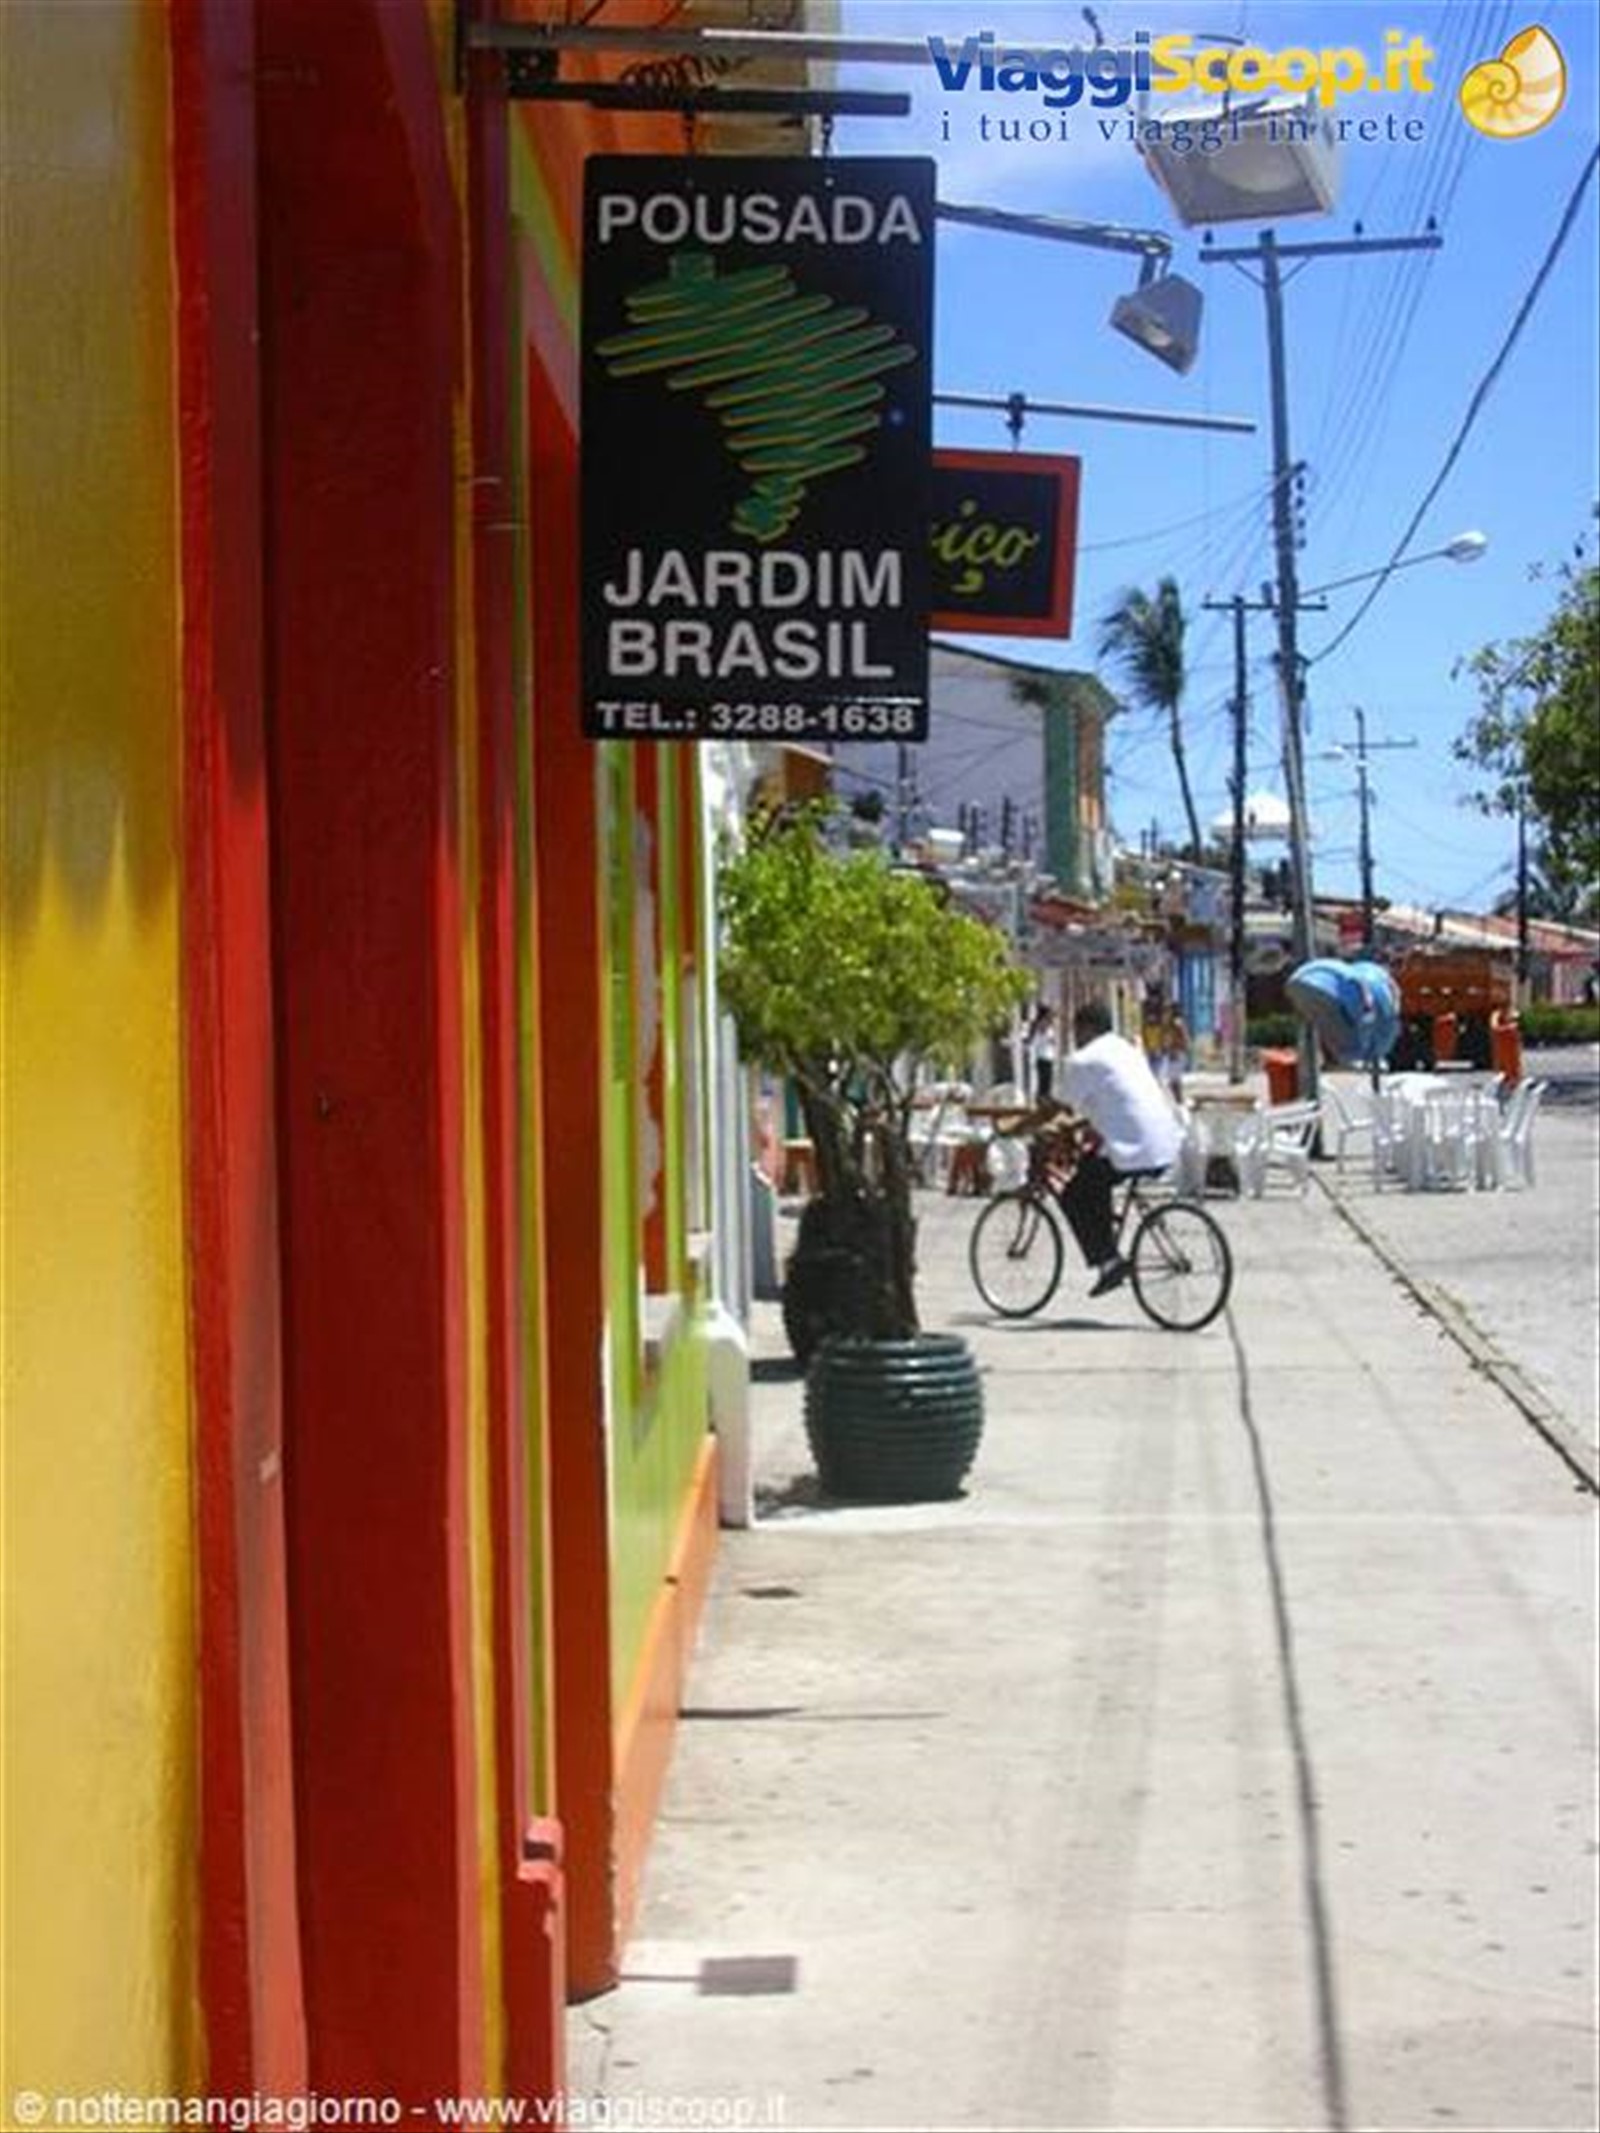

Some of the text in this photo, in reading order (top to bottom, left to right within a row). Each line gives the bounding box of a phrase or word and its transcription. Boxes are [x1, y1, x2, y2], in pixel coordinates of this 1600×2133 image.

[598, 194, 923, 245] POUSADA
[602, 549, 901, 608] JARDIM
[607, 620, 895, 679] BRASIL
[597, 702, 916, 734] TEL.: 3288-1638
